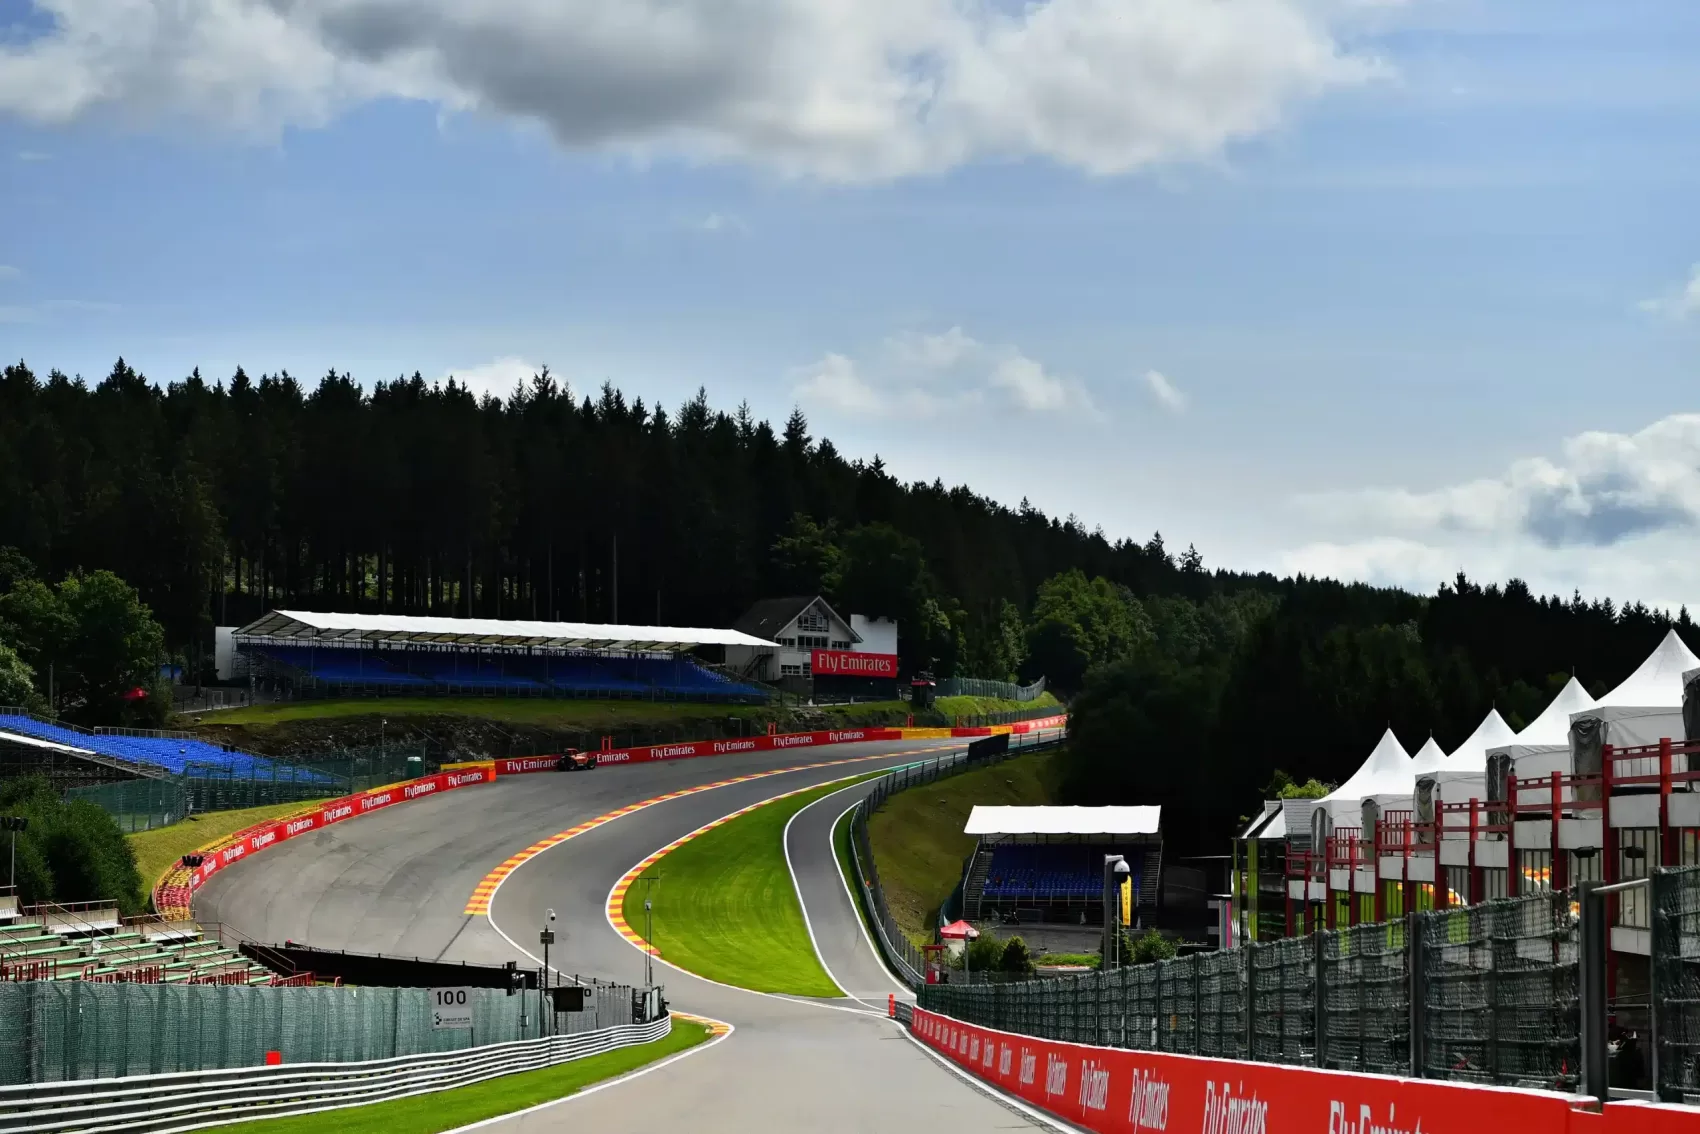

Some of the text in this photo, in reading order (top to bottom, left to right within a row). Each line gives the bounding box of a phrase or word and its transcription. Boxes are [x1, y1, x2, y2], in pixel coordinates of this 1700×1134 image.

[818, 653, 891, 672] Fly Emirates
[773, 735, 813, 747] Fly Emirates
[839, 730, 864, 740] Emirates
[650, 744, 696, 758] Fly Emirates
[714, 740, 755, 753] Fly Emirates
[596, 752, 630, 763] Emirates
[506, 760, 522, 772] Fly
[448, 771, 483, 787] Fly Emirates
[415, 782, 436, 794] Emirates
[436, 990, 466, 1005] 100
